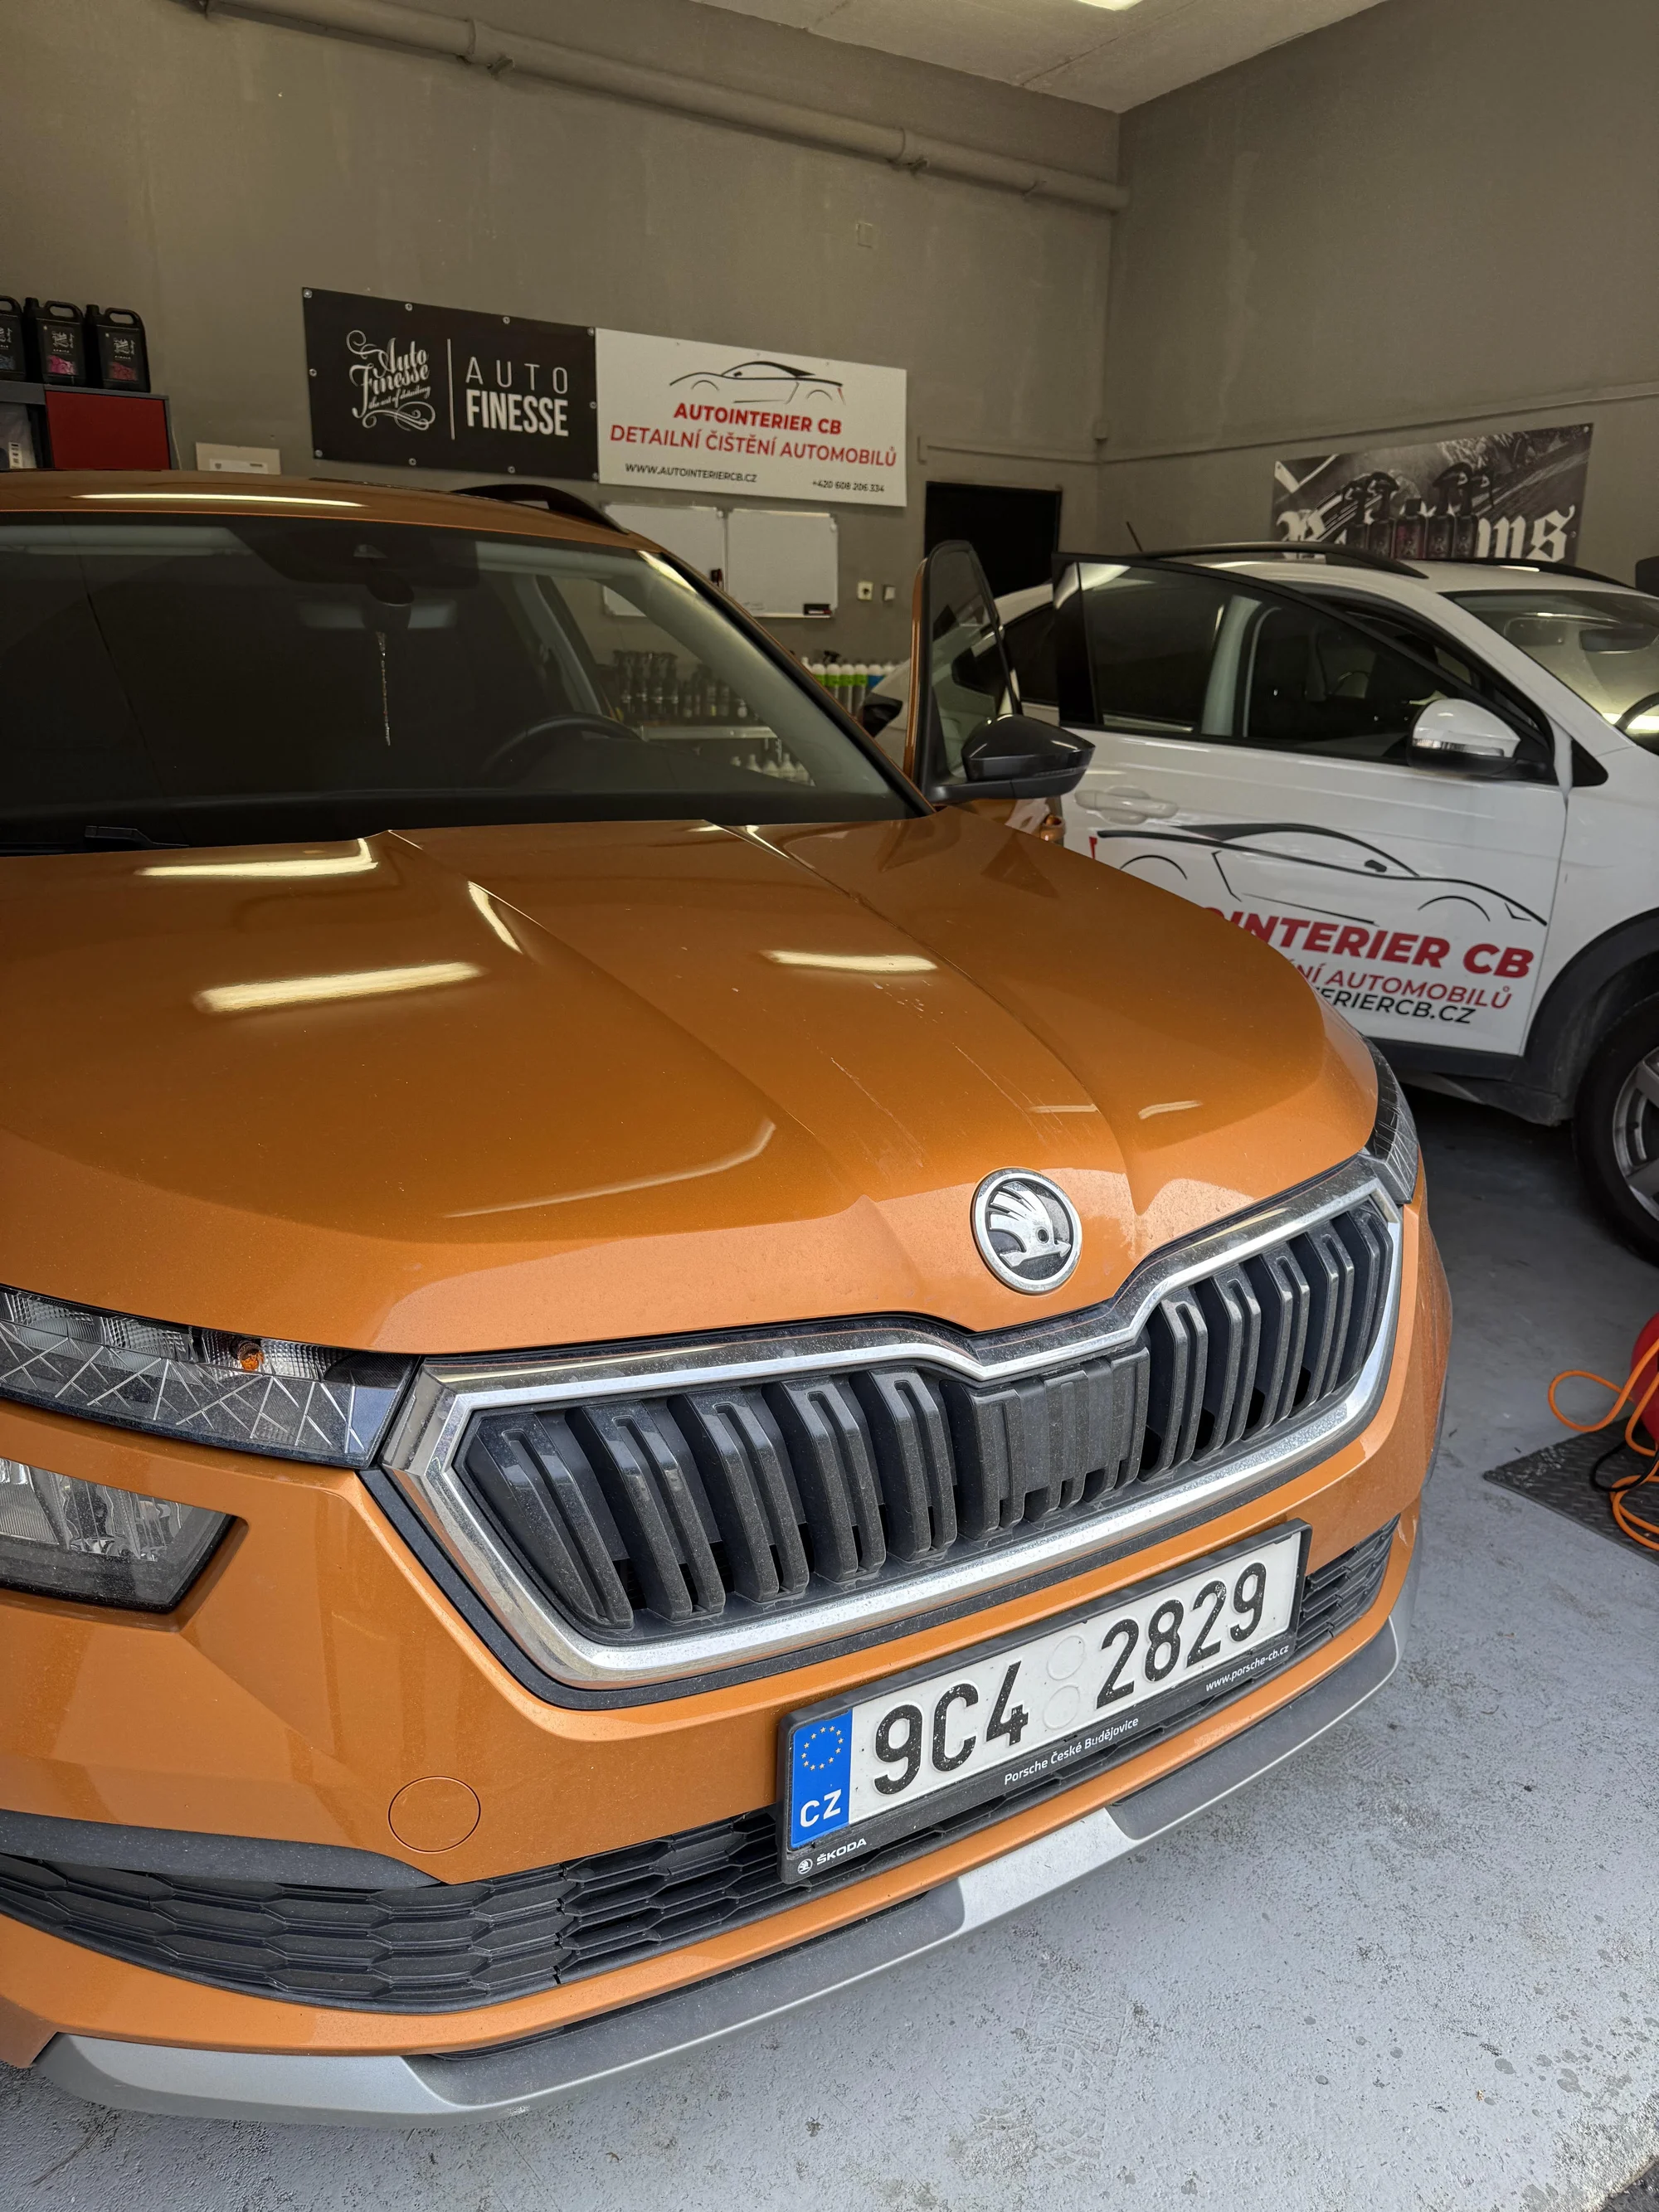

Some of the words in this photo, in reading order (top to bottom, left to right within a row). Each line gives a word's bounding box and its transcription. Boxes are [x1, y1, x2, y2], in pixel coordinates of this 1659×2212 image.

[347, 330, 429, 378] Auto
[465, 357, 569, 395] AUTO
[349, 363, 430, 418] Finesse
[466, 389, 570, 437] FINESSE
[674, 403, 812, 432] AUTOINTERIER
[819, 418, 842, 435] CB
[610, 424, 702, 450] DETAILNÍ
[706, 430, 777, 457] ČIŠTĚNÍ
[780, 442, 897, 467] AUTOMOBILŮ
[625, 463, 758, 483] WWW.AUTOINTERIERCB.CZ
[1204, 907, 1450, 969] NTERIER
[1463, 943, 1535, 979] CB
[1290, 959, 1326, 983] NÍ
[1324, 970, 1512, 1009] AUTOMOBILŮ
[1316, 987, 1477, 1024] ERIERCB.CZ
[874, 1660, 1029, 1795] 9C4
[1096, 1563, 1267, 1709] 2829
[1205, 1645, 1289, 1692] www.porsche-cb.cz
[1005, 1759, 1048, 1785] Porsche
[1050, 1743, 1082, 1764] České
[1084, 1718, 1139, 1749] Budějovice
[800, 1789, 842, 1827] CZ
[817, 1838, 867, 1865] ŠKODA
